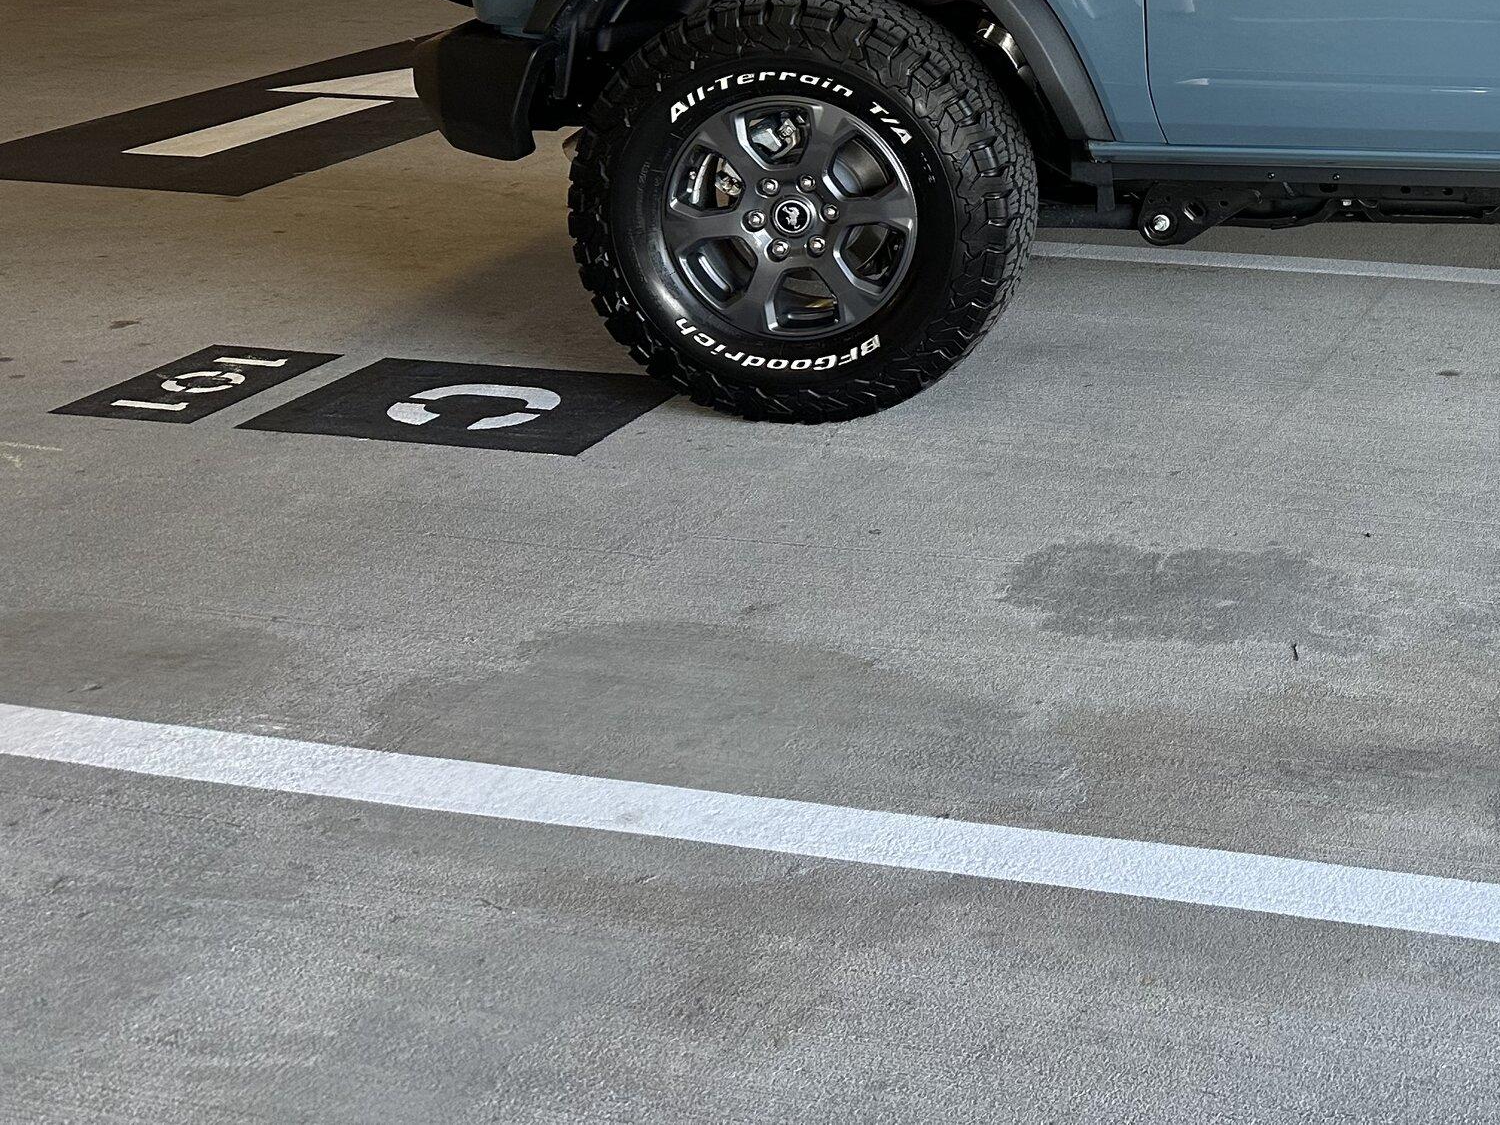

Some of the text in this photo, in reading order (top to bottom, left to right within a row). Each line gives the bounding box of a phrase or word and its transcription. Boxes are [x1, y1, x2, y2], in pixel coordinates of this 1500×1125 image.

[668, 70, 914, 146] All-Terrain T/A
[675, 316, 882, 373] BFGoodrich
[109, 356, 289, 412] 101
[386, 383, 562, 431] C
